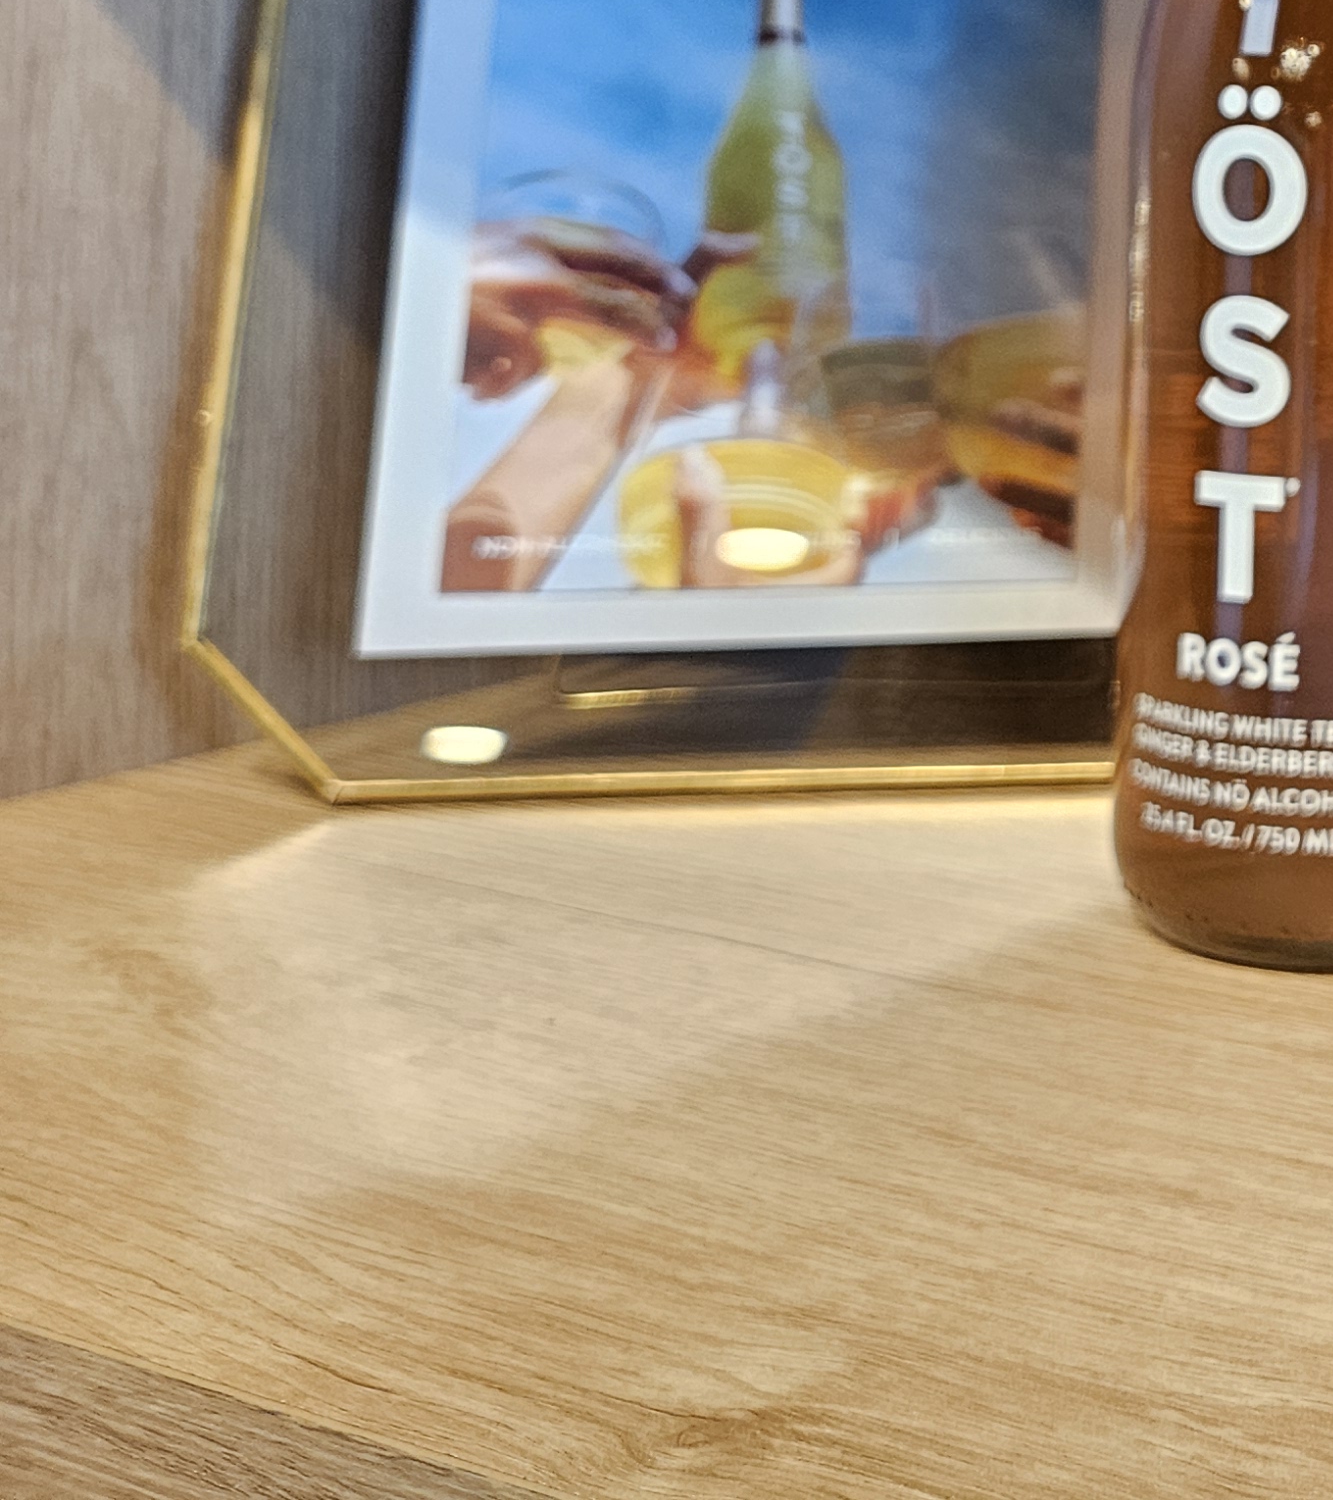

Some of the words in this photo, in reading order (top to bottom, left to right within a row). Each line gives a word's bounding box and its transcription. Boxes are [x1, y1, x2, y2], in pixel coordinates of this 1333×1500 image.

[1176, 631, 1300, 691] ROSÉ
[1230, 714, 1308, 747] WHITE
[1195, 739, 1211, 768] &
[1254, 824, 1300, 855] 750
